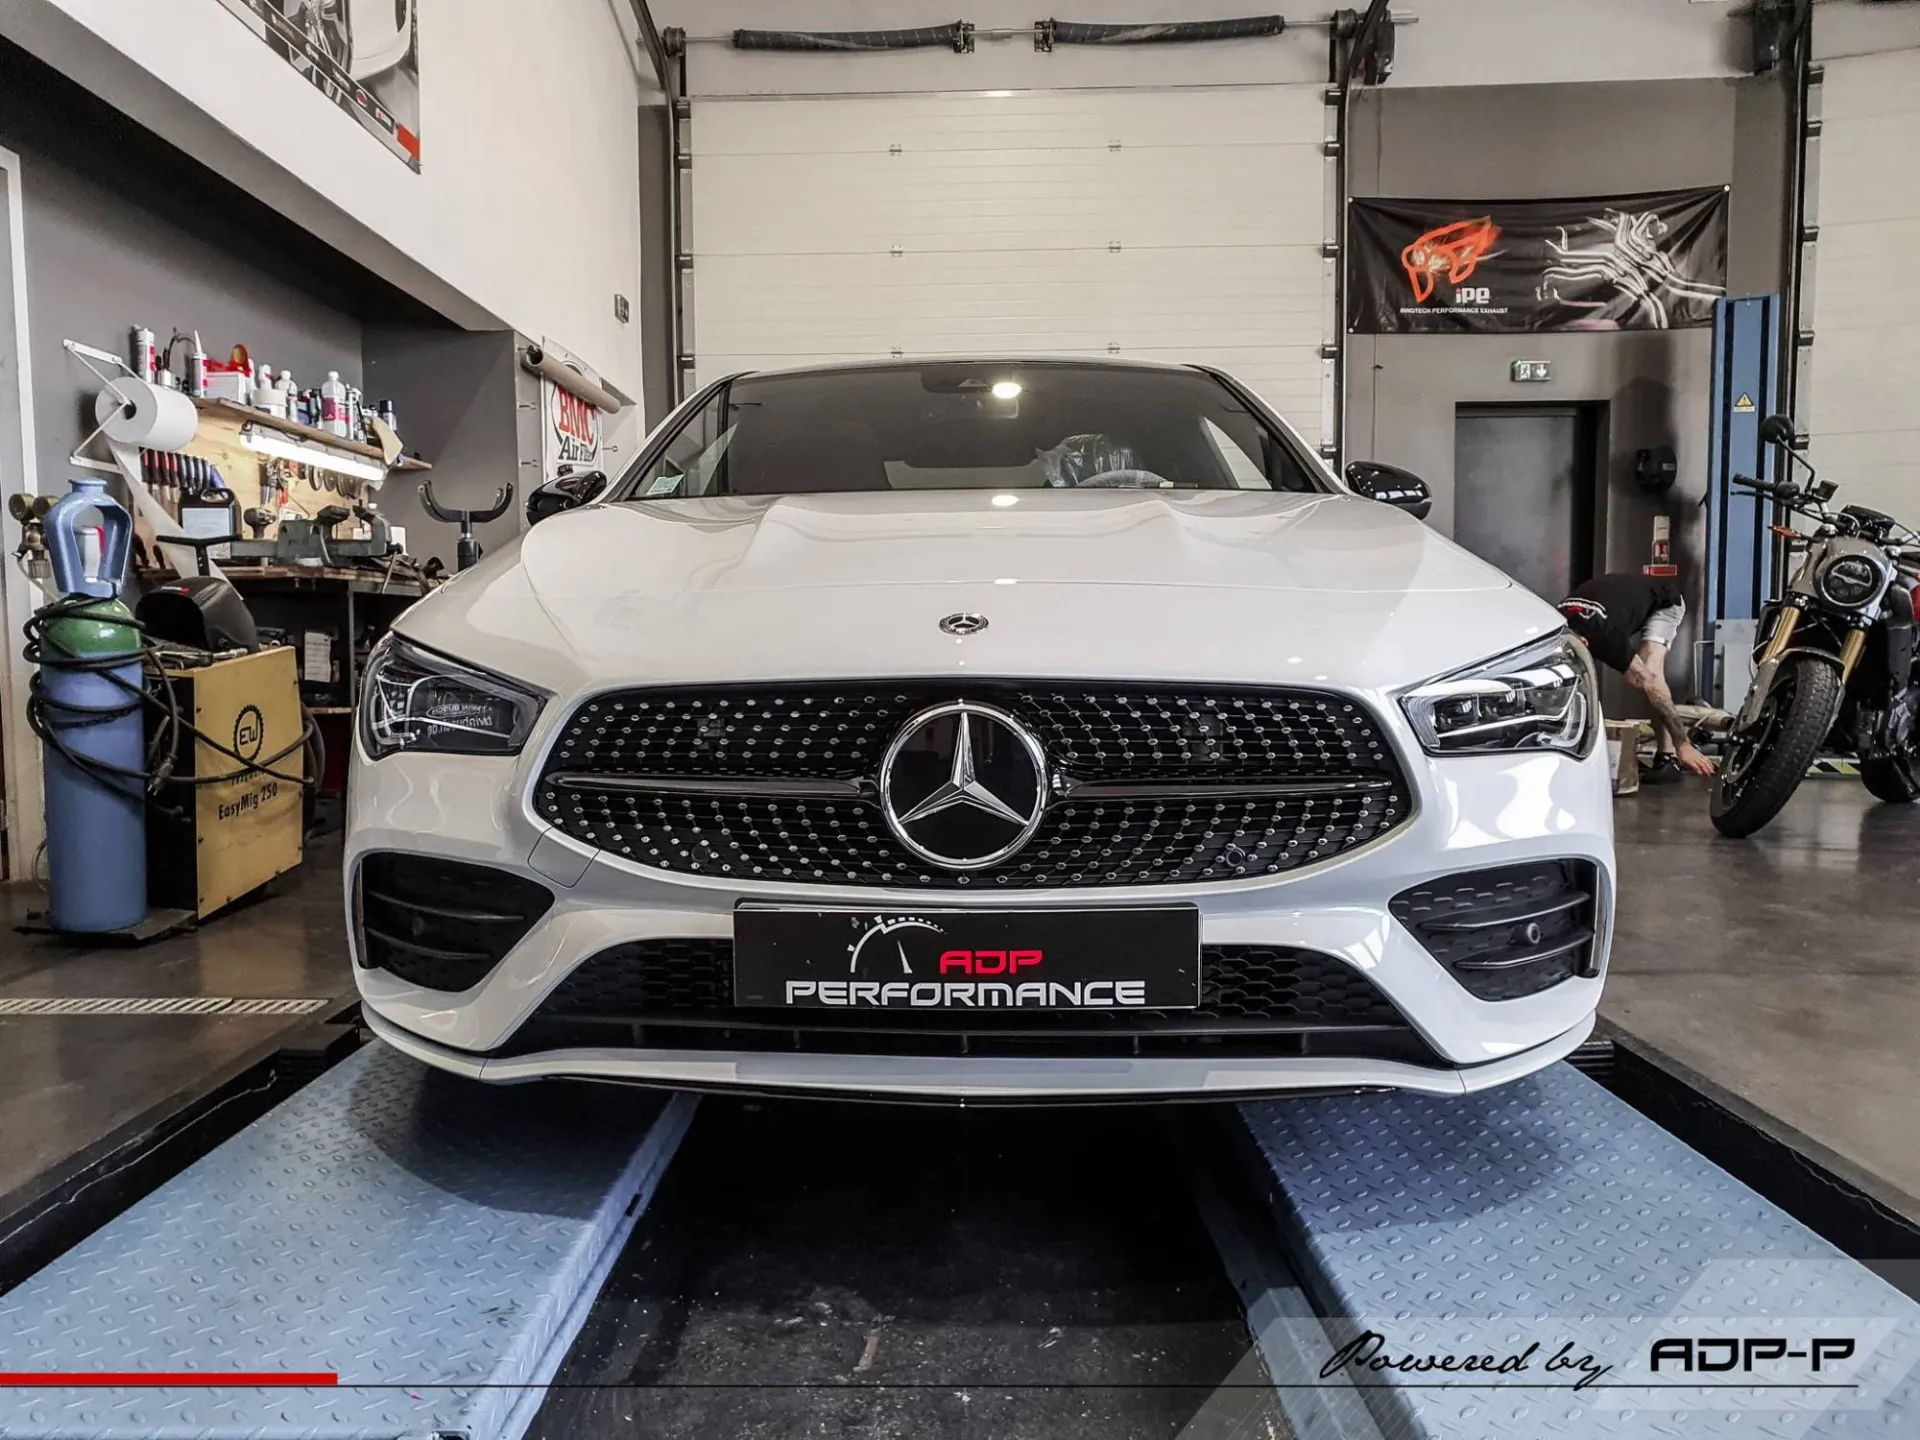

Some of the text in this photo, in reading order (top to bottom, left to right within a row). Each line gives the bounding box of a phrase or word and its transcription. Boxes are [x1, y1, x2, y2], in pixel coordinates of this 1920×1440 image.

[558, 387, 597, 446] BMC
[558, 435, 579, 461] Air
[218, 782, 278, 820] EasyMig 250
[939, 950, 1043, 974] ADP
[786, 981, 1145, 1006] PERFORMANCE
